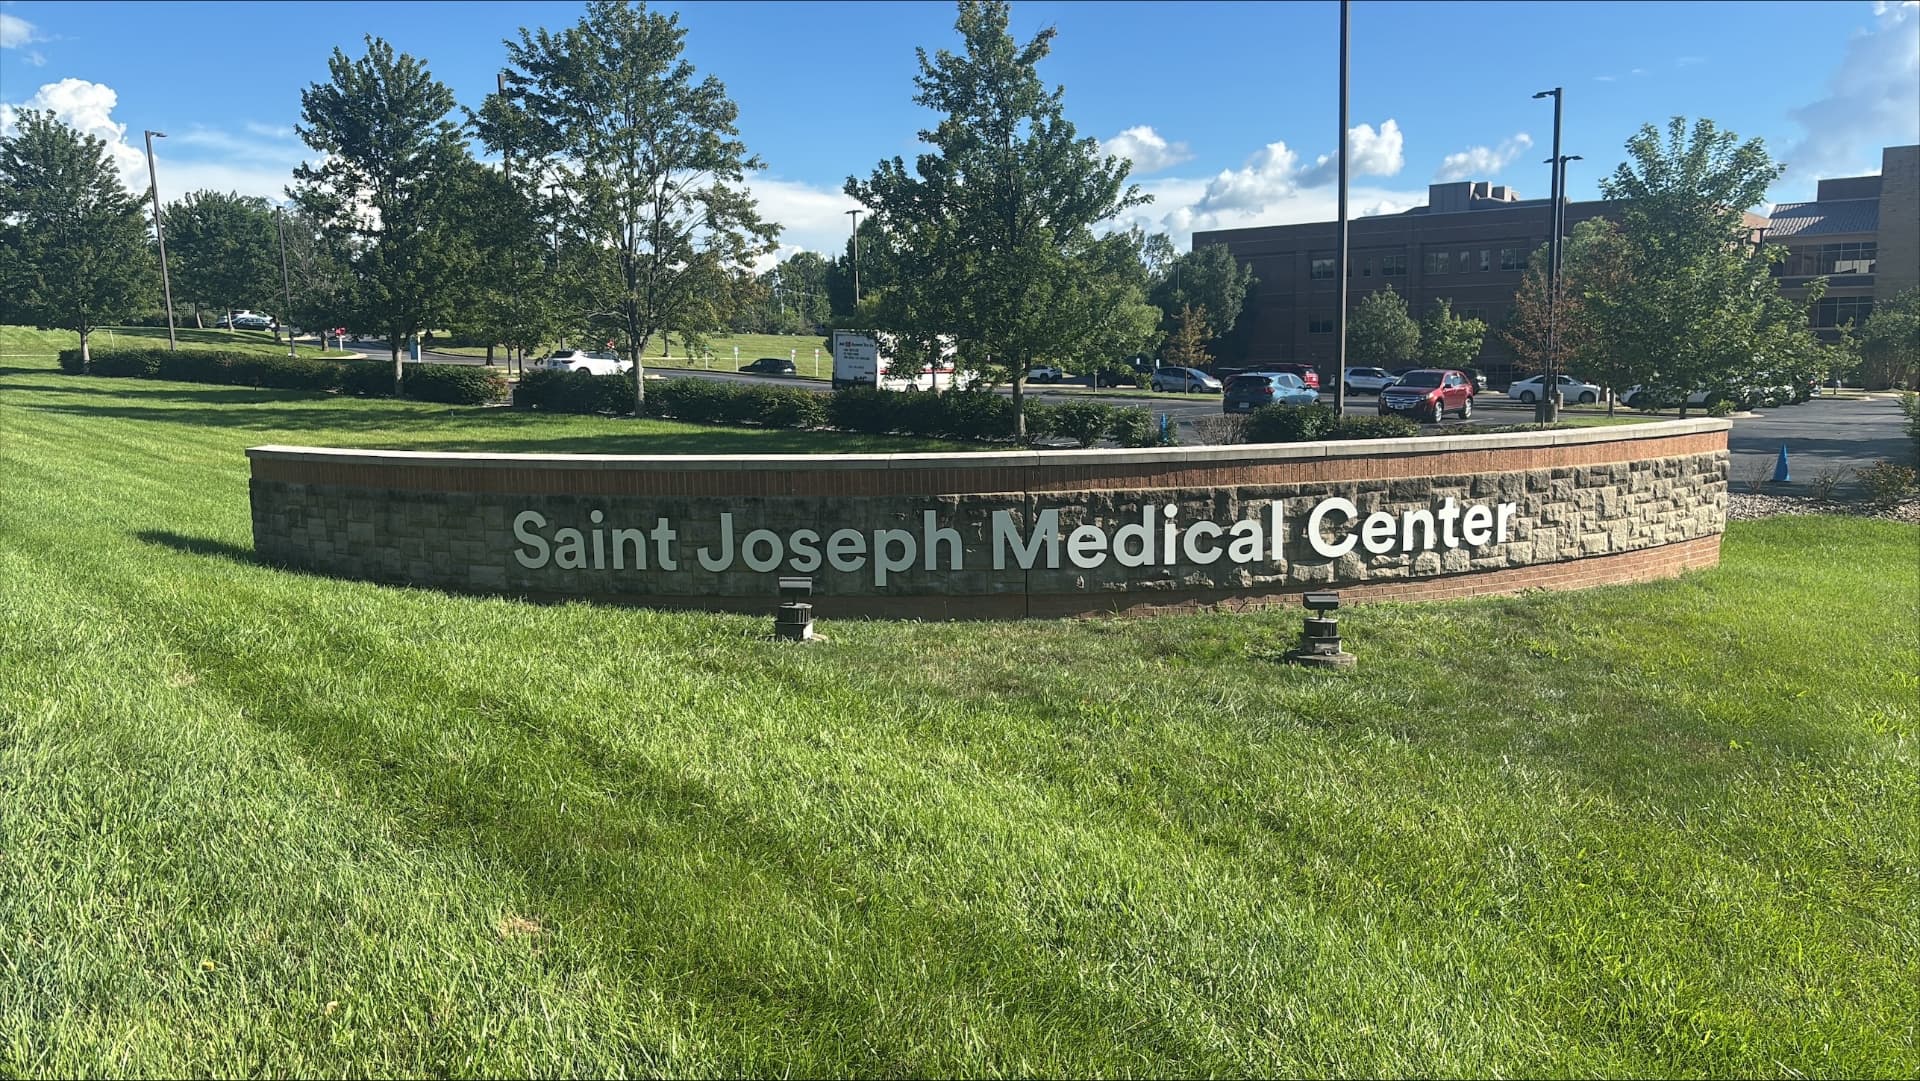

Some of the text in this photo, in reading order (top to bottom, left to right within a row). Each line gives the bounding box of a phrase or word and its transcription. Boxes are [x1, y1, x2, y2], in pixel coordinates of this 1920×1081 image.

[513, 497, 1517, 587] Saint Joseph Medical Center
